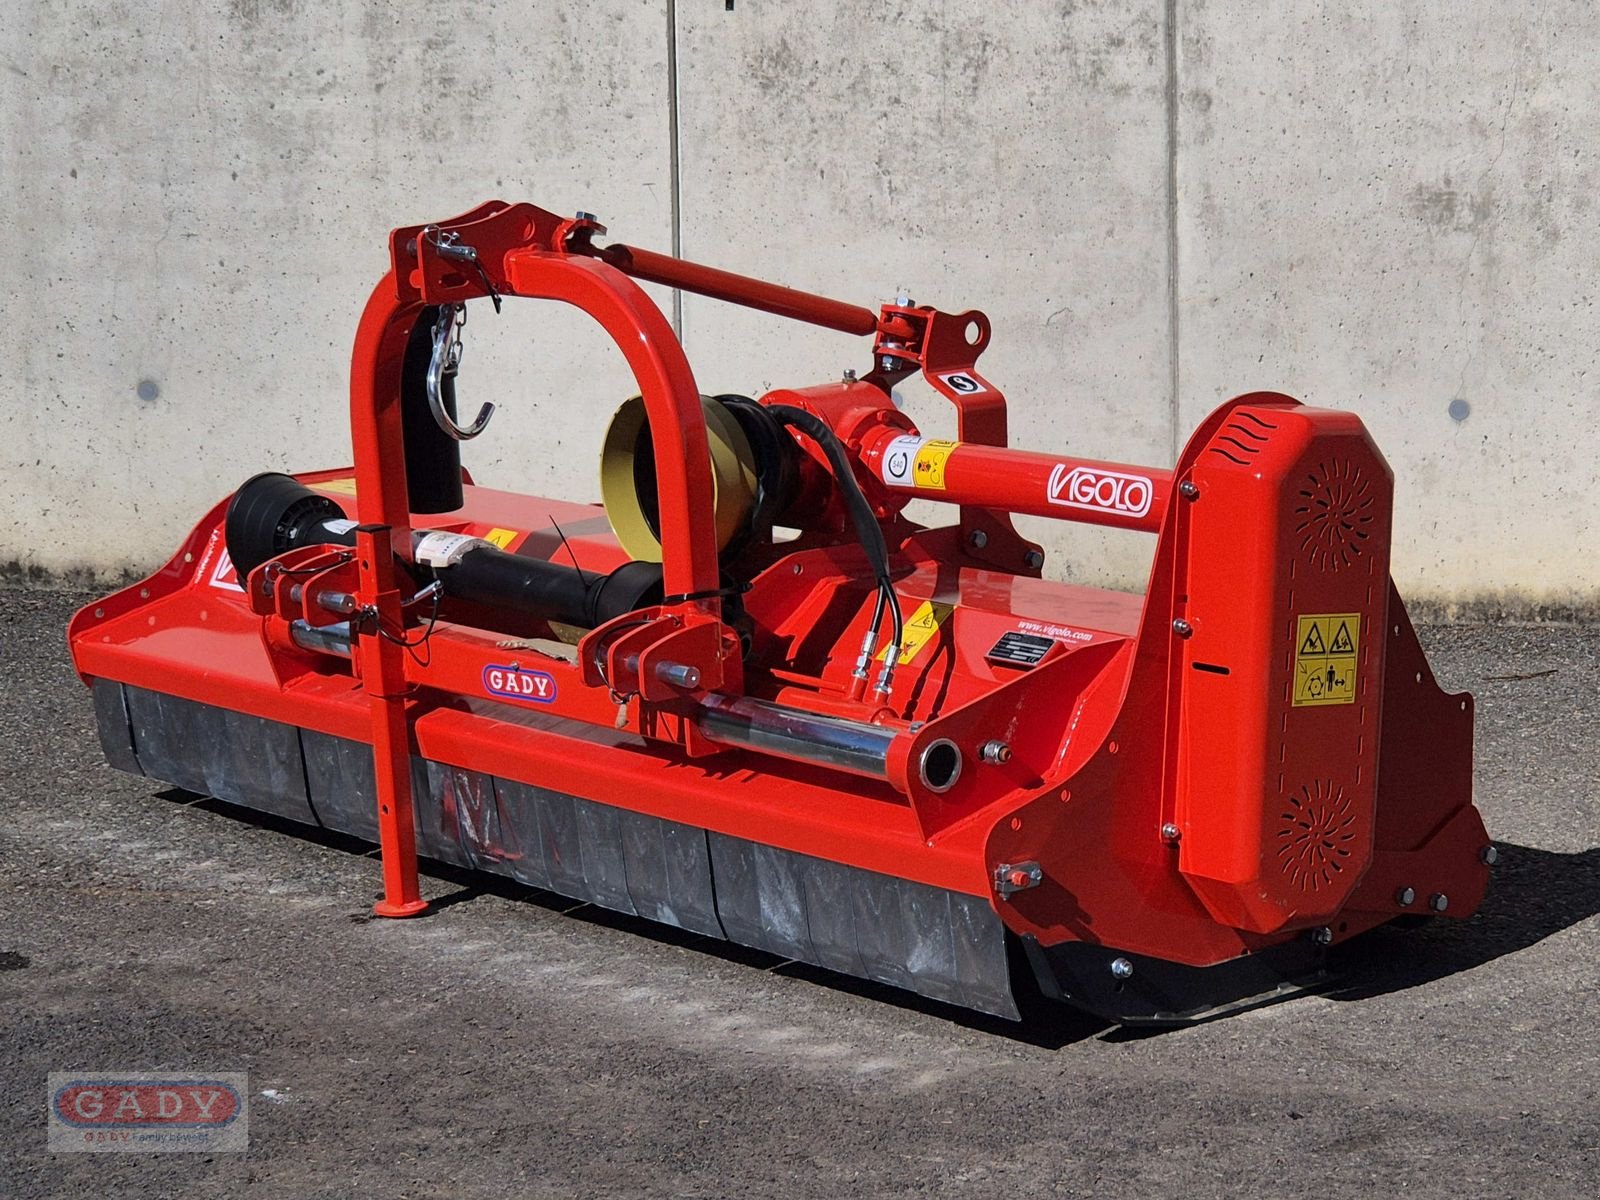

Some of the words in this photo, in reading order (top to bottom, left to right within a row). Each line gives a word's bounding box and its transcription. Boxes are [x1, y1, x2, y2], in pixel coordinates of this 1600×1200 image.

[1048, 463, 1149, 514] VIGOLO
[1017, 621, 1093, 641] www.vigolo.com
[490, 670, 548, 697] GADY
